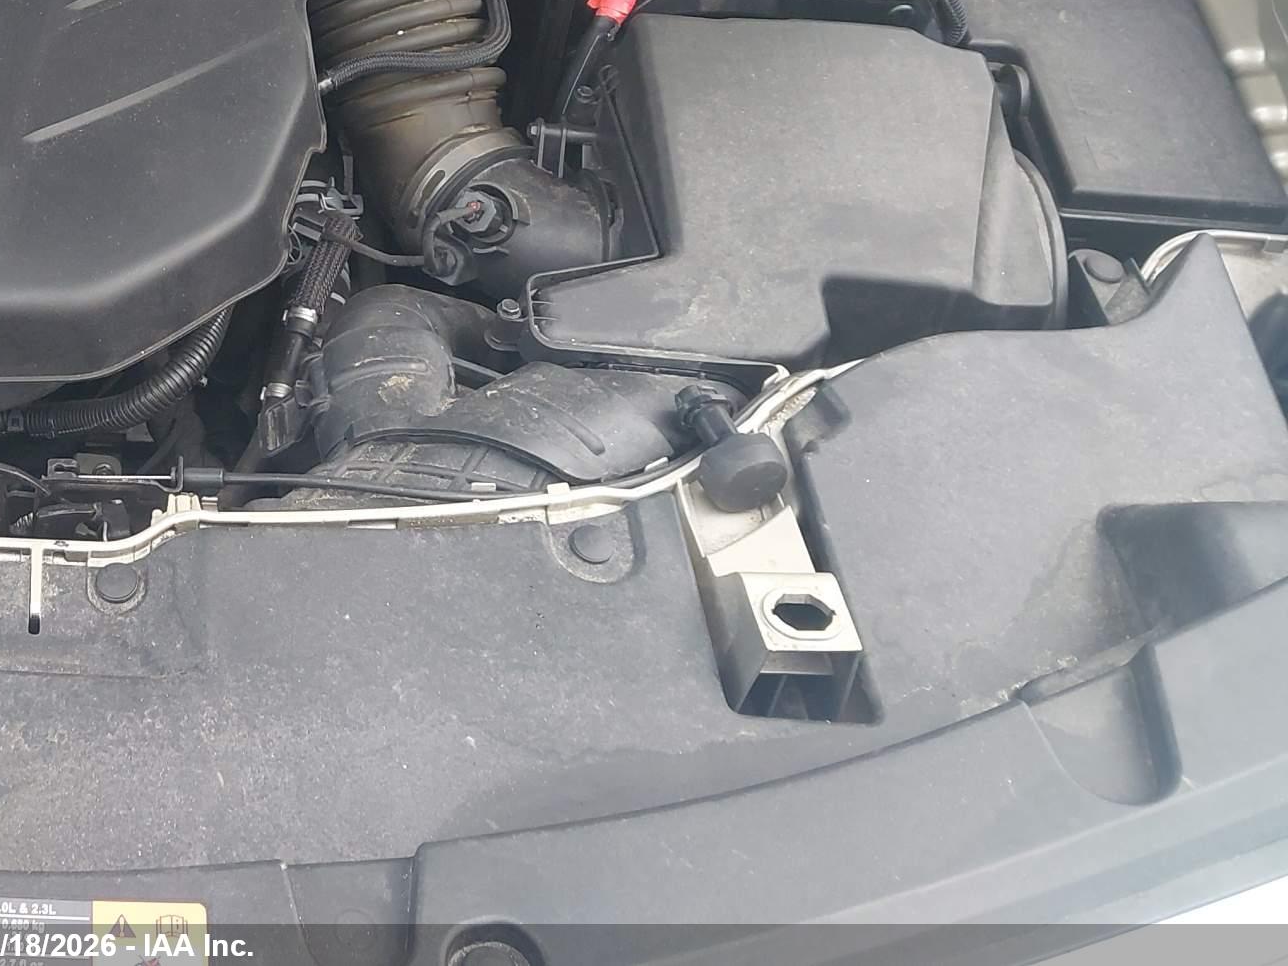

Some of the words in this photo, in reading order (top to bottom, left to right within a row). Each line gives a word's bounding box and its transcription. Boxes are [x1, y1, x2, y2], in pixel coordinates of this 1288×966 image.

[19, 902, 28, 914] &
[31, 903, 57, 915] 2.3L
[31, 920, 45, 933] kg
[0, 958, 18, 966] 27
